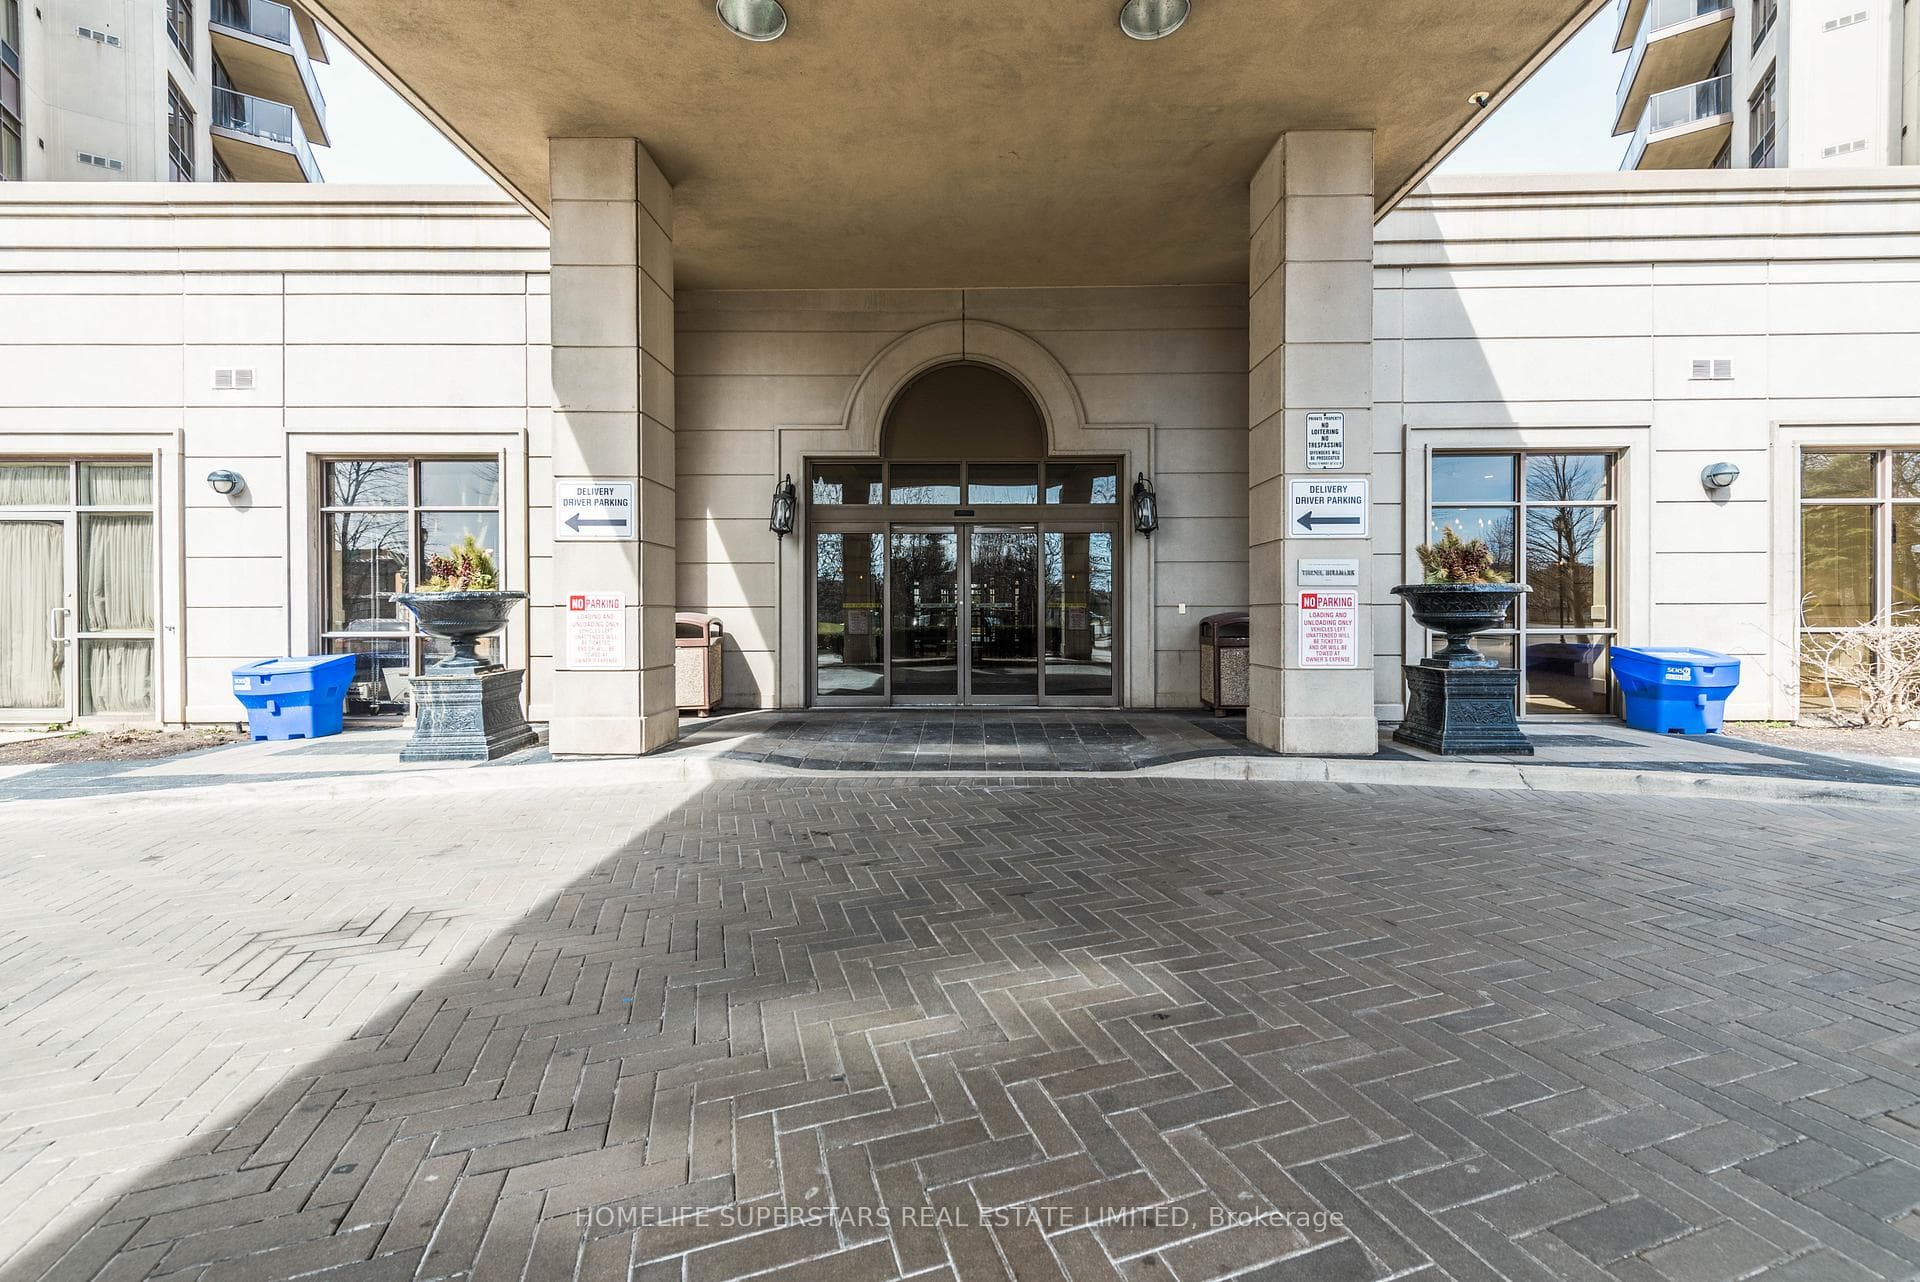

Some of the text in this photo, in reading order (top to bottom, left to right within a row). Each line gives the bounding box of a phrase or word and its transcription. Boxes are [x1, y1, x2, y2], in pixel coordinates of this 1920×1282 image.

[577, 488, 614, 496] DELIVERY
[1309, 486, 1348, 494] DELIVERY
[563, 498, 628, 506] DRIVER PARKING
[1295, 496, 1362, 504] DRIVER PARKING
[572, 598, 620, 609] NO PARKING
[1304, 597, 1352, 607] NO PARKING
